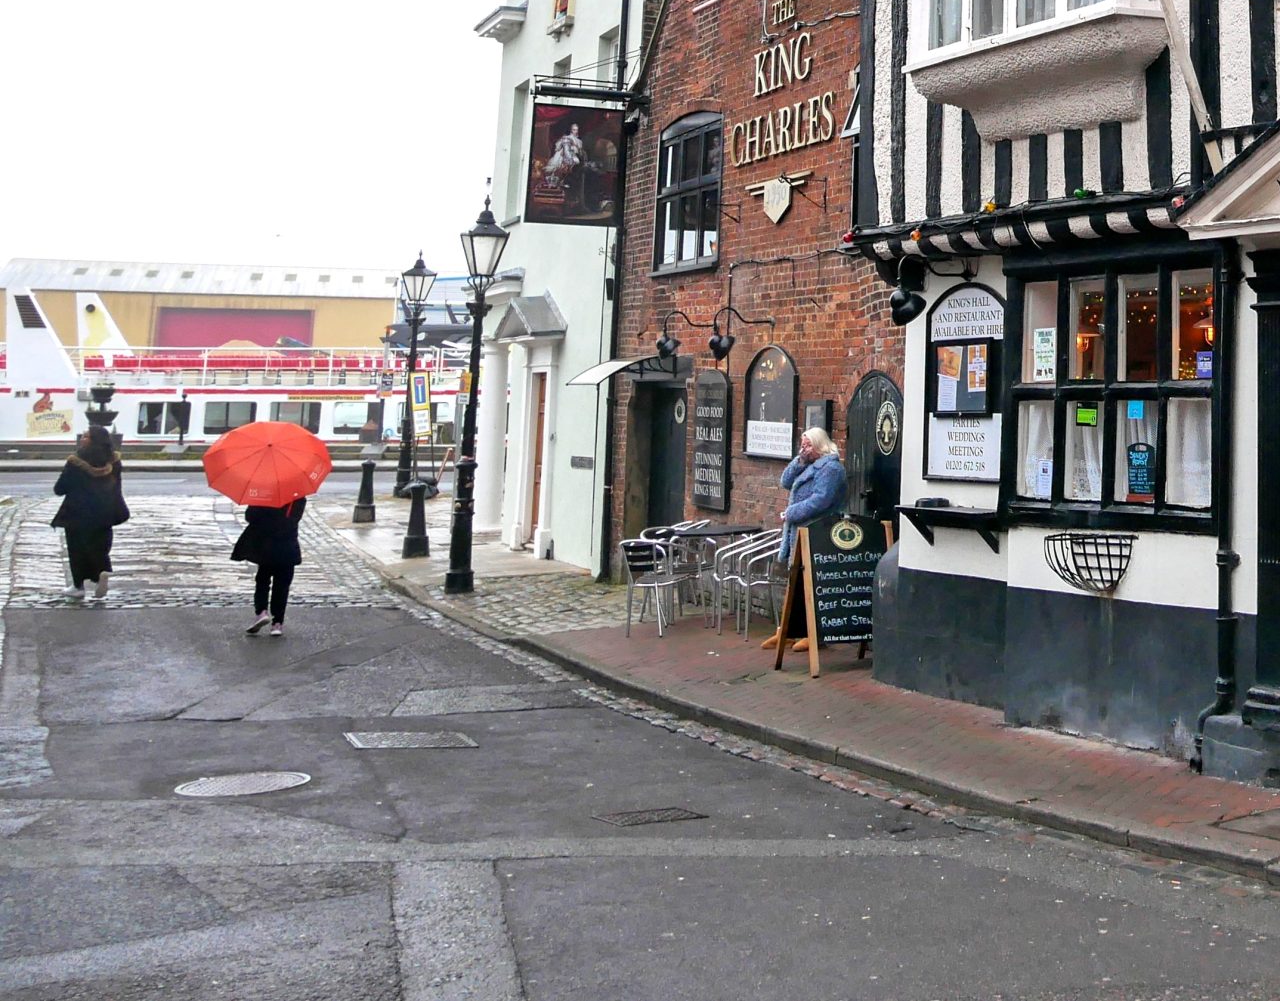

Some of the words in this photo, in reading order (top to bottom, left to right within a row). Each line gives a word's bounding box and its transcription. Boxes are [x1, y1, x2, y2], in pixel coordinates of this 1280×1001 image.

[753, 31, 813, 98] KING
[730, 91, 835, 168] CHARLES
[947, 298, 972, 309] KING'S
[972, 297, 991, 307] HALL
[954, 310, 1001, 323] RESTAURANT
[934, 326, 971, 338] AVAILABLE
[971, 325, 985, 336] FOR
[986, 324, 1004, 335] HIRE
[696, 406, 710, 418] GOOD
[710, 406, 724, 418] FOOD
[952, 419, 981, 428] PARTIES
[696, 426, 709, 441] REAL
[709, 427, 723, 442] ALES
[947, 432, 985, 443] WEDDINGS
[948, 446, 984, 457] MEETINGS
[695, 452, 722, 466] STUNNING
[945, 461, 963, 471] 01202
[963, 461, 974, 471] 672
[975, 461, 985, 472] 518
[694, 467, 722, 483] MEDIEVAL
[709, 484, 722, 497] HALL
[813, 553, 837, 564] FRESH
[818, 599, 838, 611] BEEF
[821, 616, 848, 628] RABBIT
